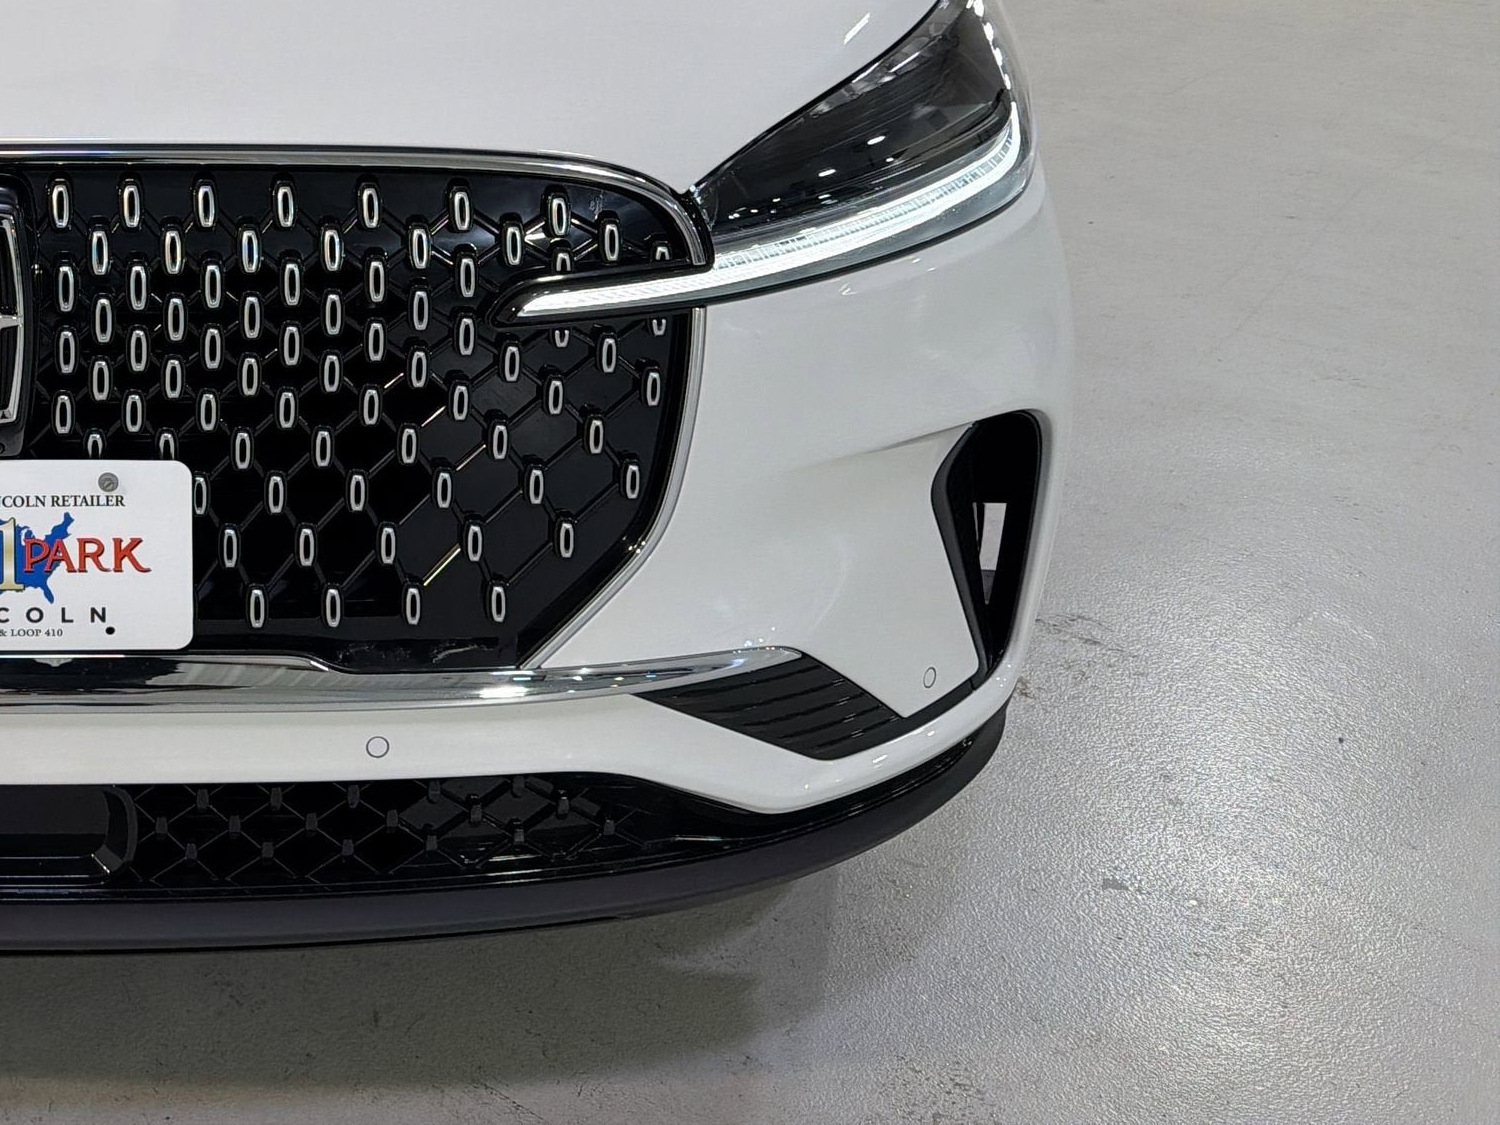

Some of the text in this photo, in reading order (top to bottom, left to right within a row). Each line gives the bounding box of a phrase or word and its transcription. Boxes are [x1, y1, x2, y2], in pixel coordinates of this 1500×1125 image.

[51, 494, 126, 507] RETAILER
[23, 537, 152, 573] PARK
[10, 628, 42, 637] LOOP
[44, 628, 63, 637] 410
